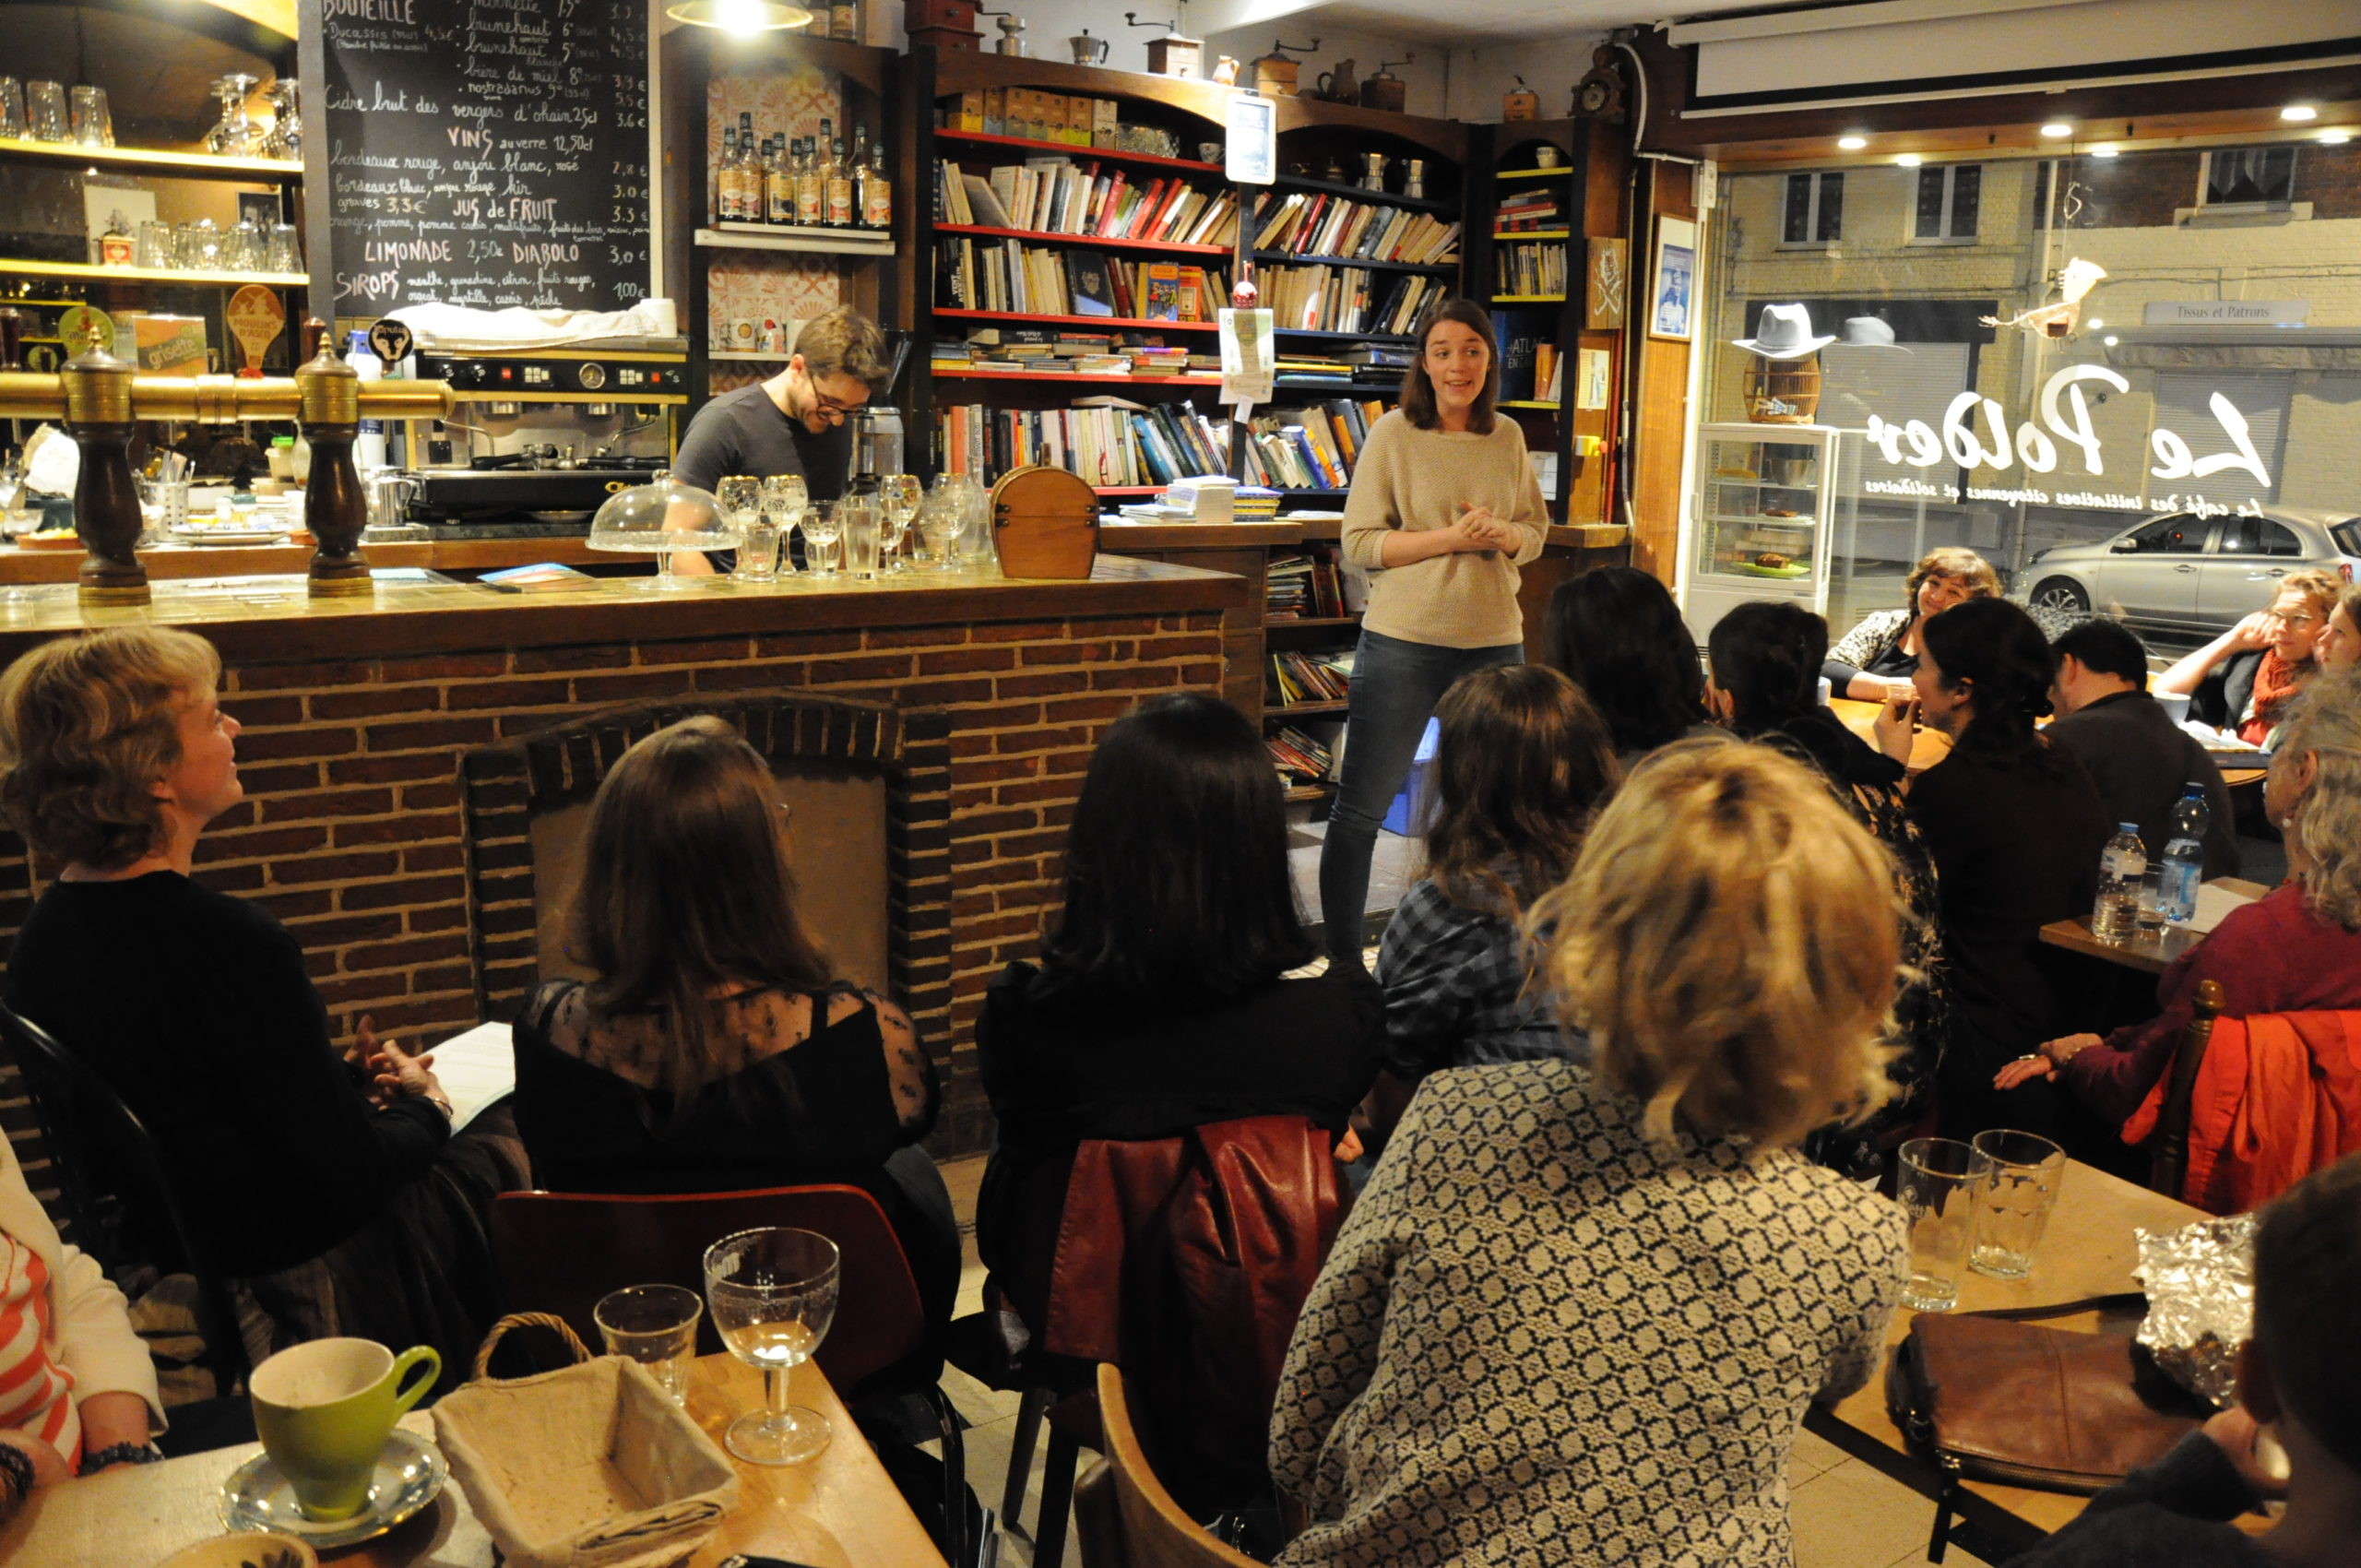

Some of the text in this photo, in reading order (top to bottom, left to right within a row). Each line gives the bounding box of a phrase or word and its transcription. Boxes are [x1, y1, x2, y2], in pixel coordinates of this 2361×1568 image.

[466, 7, 552, 36] brunehaut
[464, 31, 547, 58] brunehaut
[507, 65, 525, 82] de
[531, 67, 563, 84] miel
[325, 84, 368, 112] Cidre
[371, 80, 409, 112] brut
[416, 95, 439, 113] des
[452, 104, 504, 130] vergers
[447, 126, 493, 160] VINS
[499, 139, 514, 149] au
[515, 139, 548, 149] verre
[330, 140, 400, 169] bordeaux
[453, 157, 496, 184] anjou
[555, 155, 580, 172] rosé
[335, 172, 398, 193] bordeaux
[337, 197, 381, 213] graves
[453, 198, 481, 226] JUS
[487, 198, 506, 219] de
[509, 198, 558, 223] FRUIT
[417, 219, 457, 237] pomme
[364, 239, 453, 269] LIMONADE
[512, 242, 580, 270] DIABOLO
[332, 268, 400, 302] SIROPS
[232, 316, 279, 332] MOULINS
[2176, 305, 2270, 319] Tissus et Patrons
[148, 337, 199, 370] grisette
